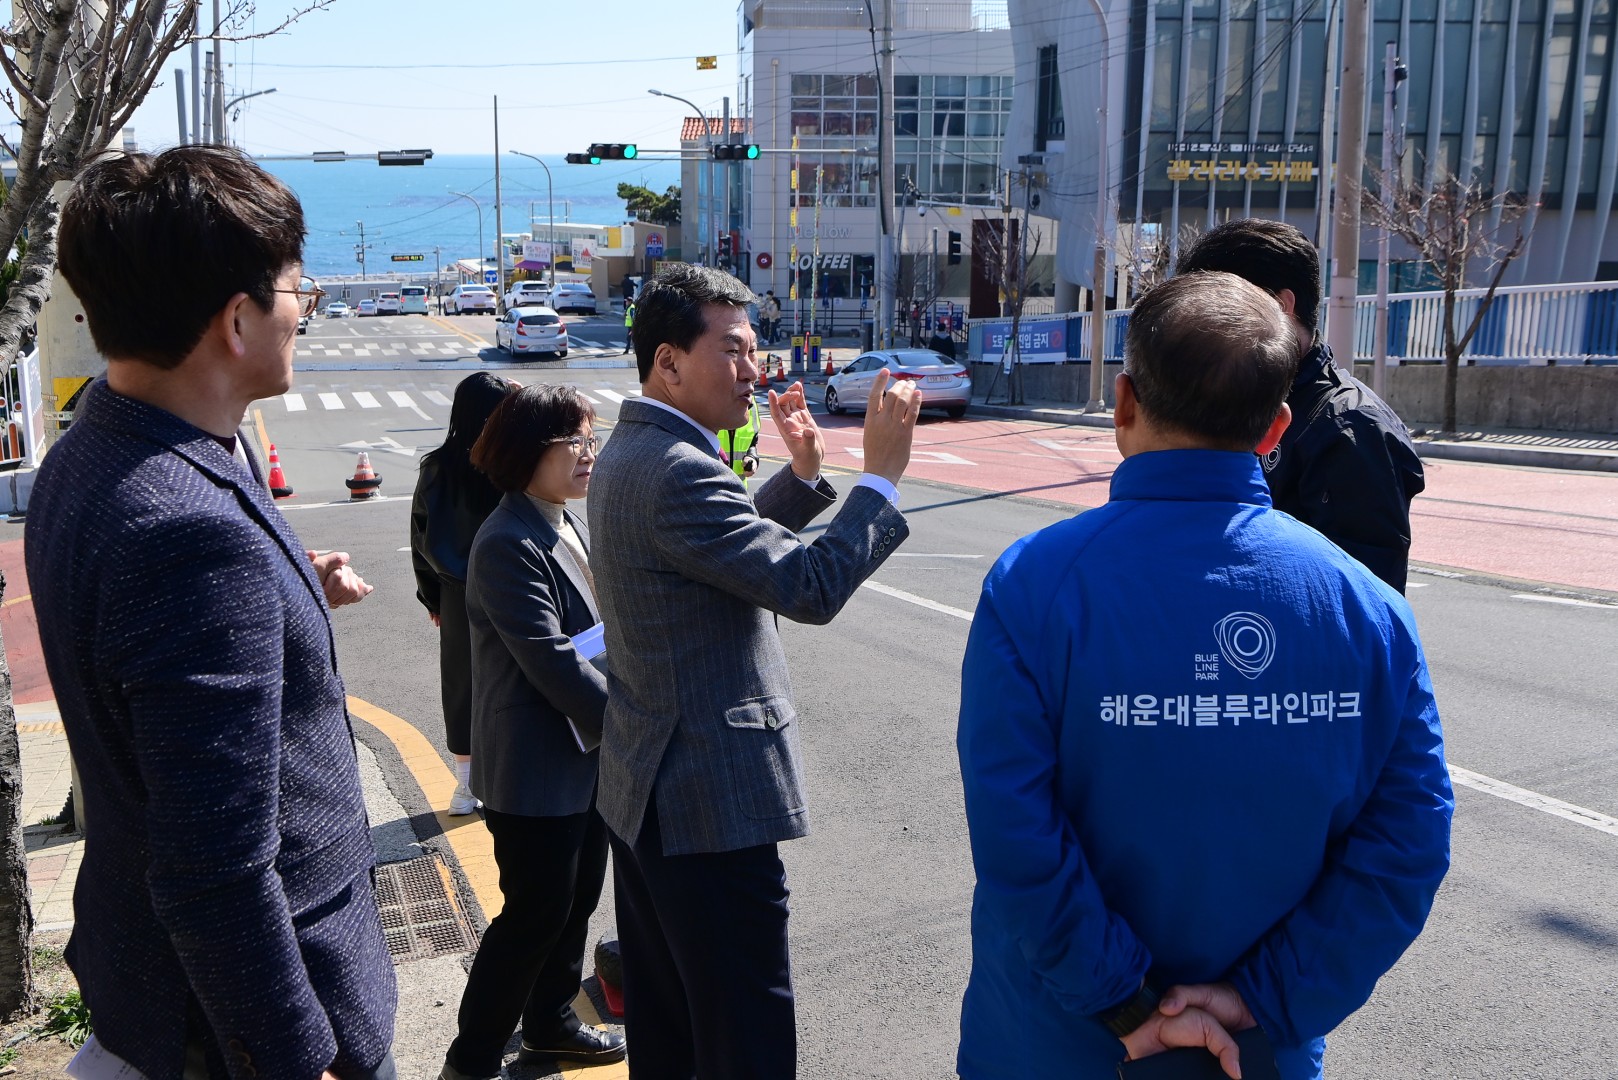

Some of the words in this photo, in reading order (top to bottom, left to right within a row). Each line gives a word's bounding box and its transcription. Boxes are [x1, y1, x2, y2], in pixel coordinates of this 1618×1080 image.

[1168, 160, 1312, 181] 갤러리&카페
[789, 223, 850, 238] Melow
[992, 334, 1003, 348] 도로
[1033, 332, 1049, 348] 금지
[1195, 654, 1219, 662] BLUE
[1195, 663, 1219, 671] LINE
[1195, 672, 1220, 681] PARK
[1100, 690, 1361, 726] 해운대블루라인파크
